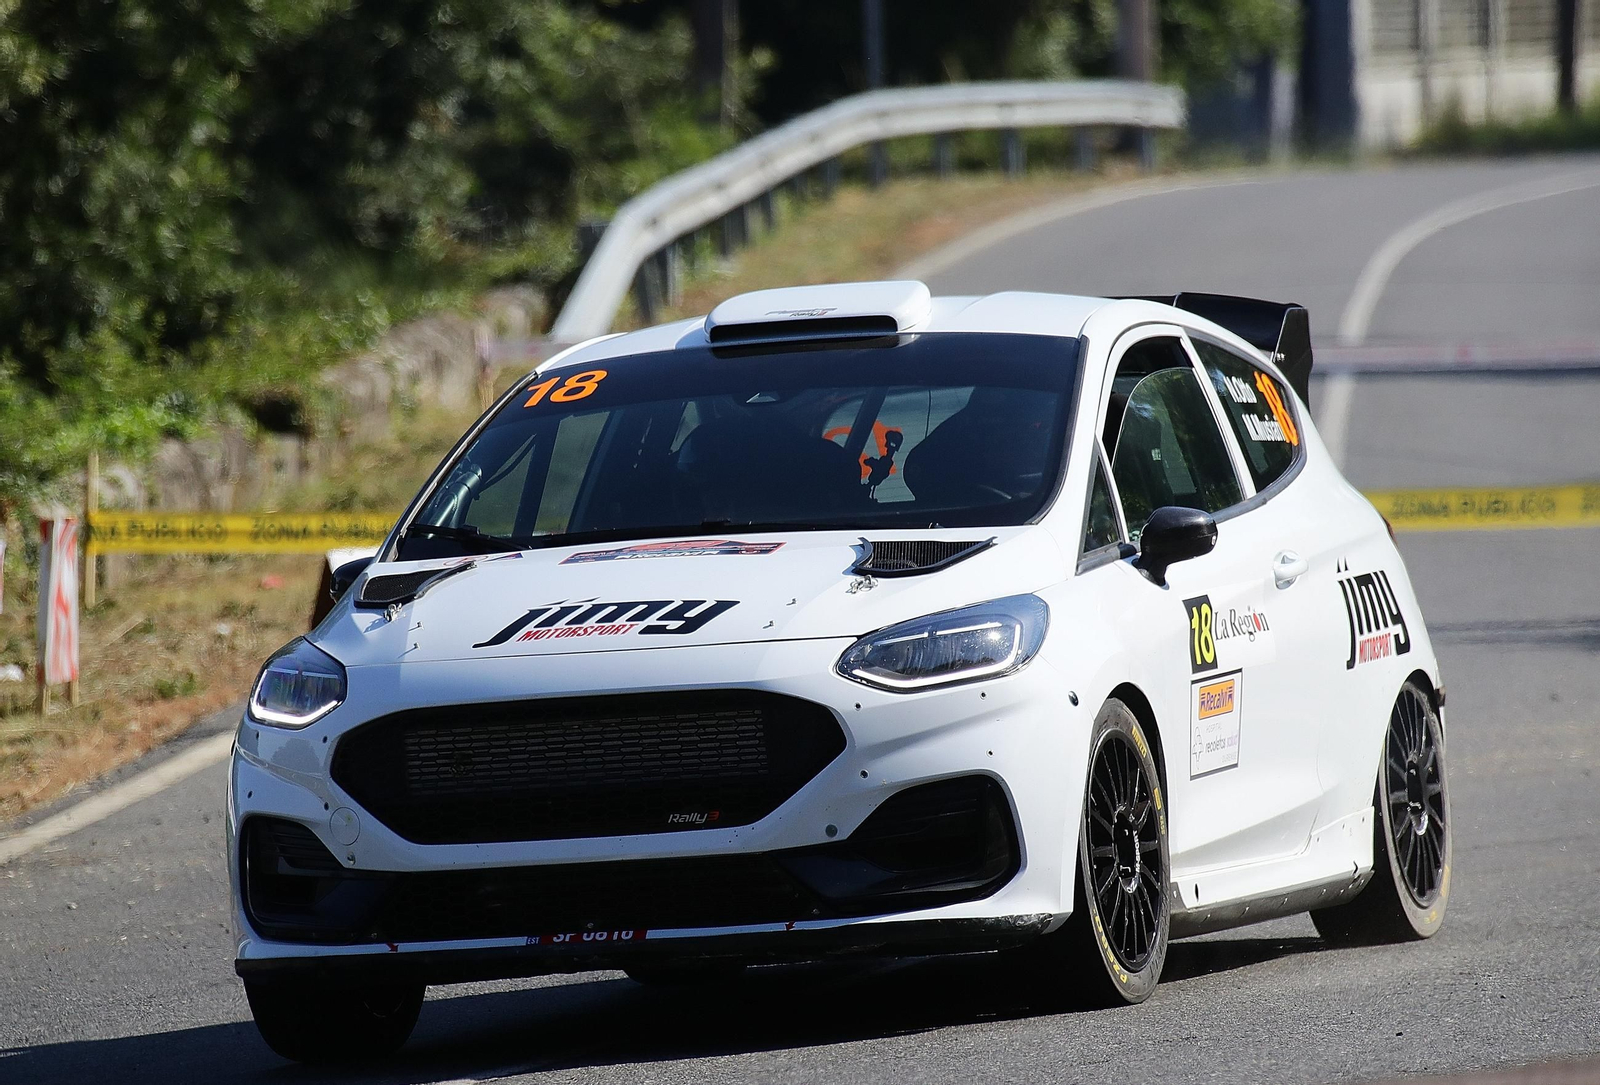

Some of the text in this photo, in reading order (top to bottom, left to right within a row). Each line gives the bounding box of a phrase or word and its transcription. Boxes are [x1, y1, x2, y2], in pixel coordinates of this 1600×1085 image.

[524, 370, 608, 408] 18
[1254, 371, 1298, 446] 18
[473, 597, 740, 648] jimy
[1215, 610, 1229, 640] La
[1336, 556, 1411, 670] jimy
[516, 622, 640, 643] MOTORSPORT
[1192, 603, 1215, 665] 18
[1359, 632, 1392, 664] MOTORSPORT
[668, 811, 720, 824] Rally3
[527, 937, 540, 945] EST
